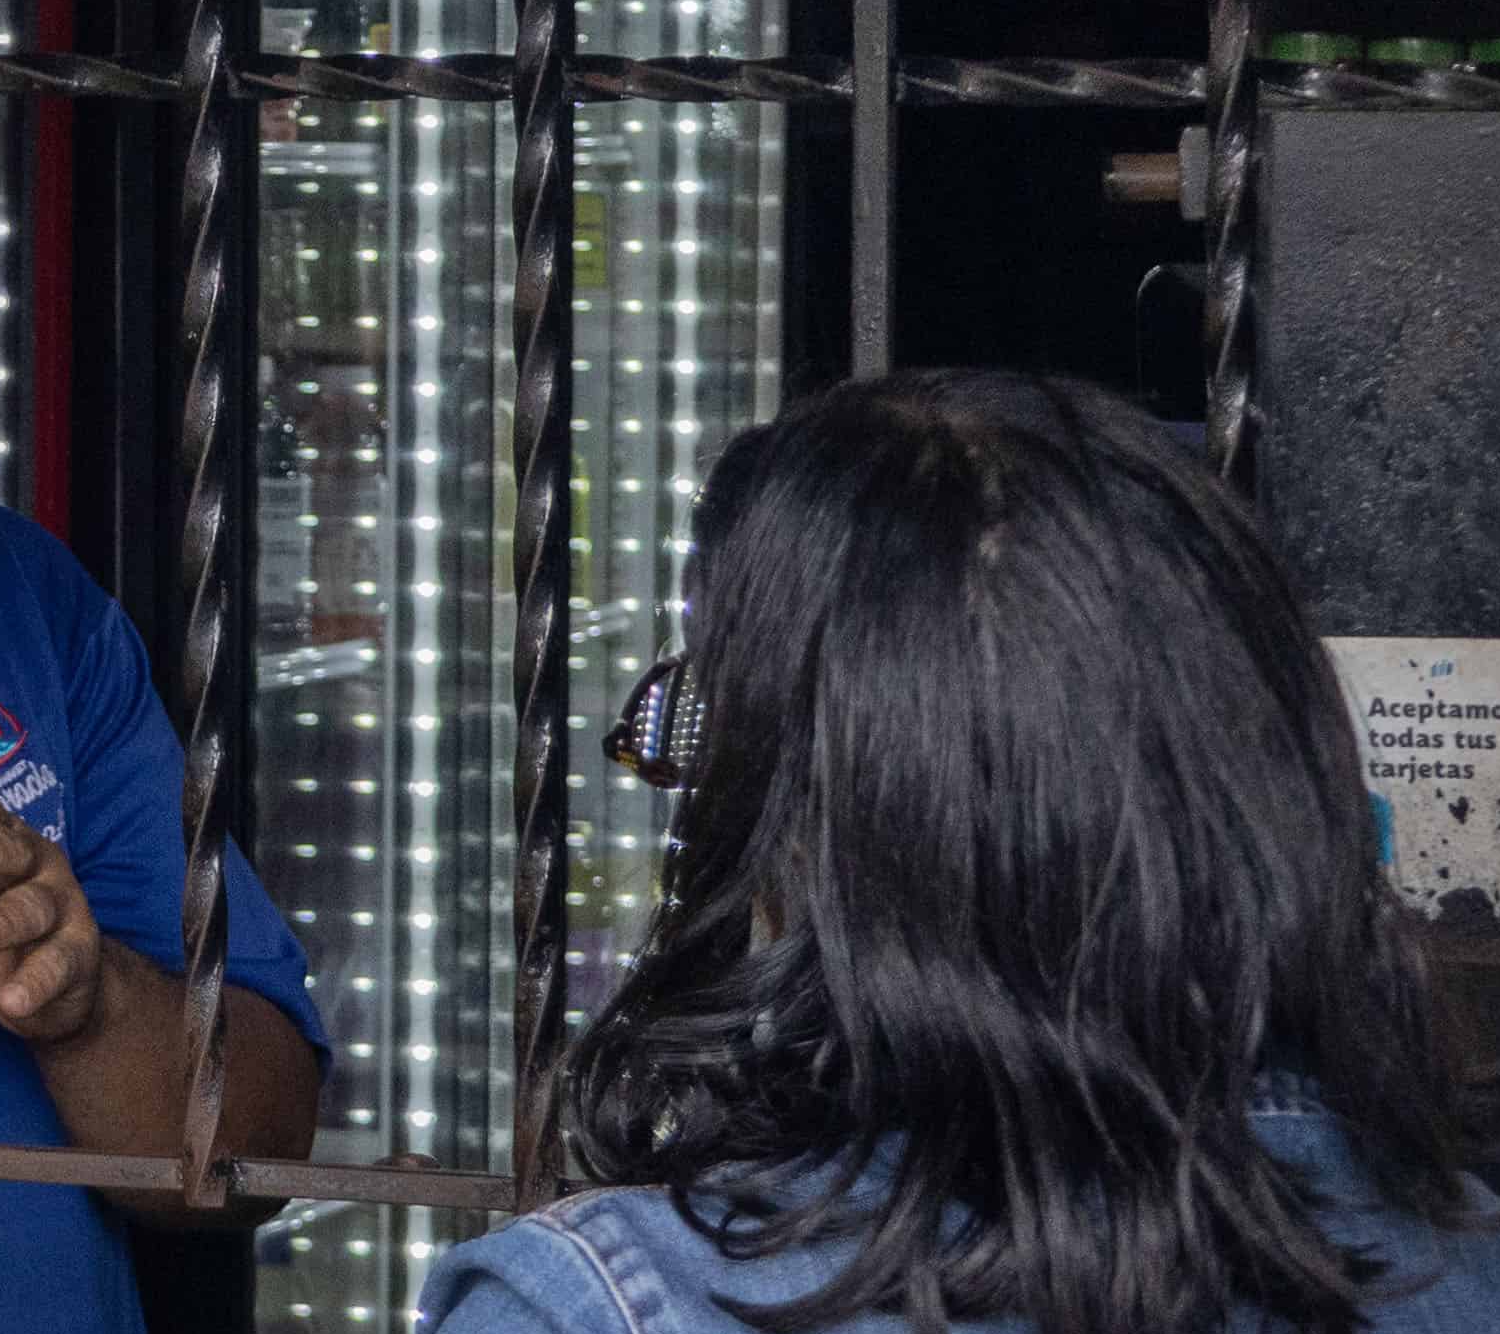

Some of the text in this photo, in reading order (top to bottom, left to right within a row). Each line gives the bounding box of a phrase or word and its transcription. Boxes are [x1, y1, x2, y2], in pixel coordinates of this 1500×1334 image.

[1369, 728, 1497, 750] todas tus
[1369, 756, 1475, 783] tarjetas
